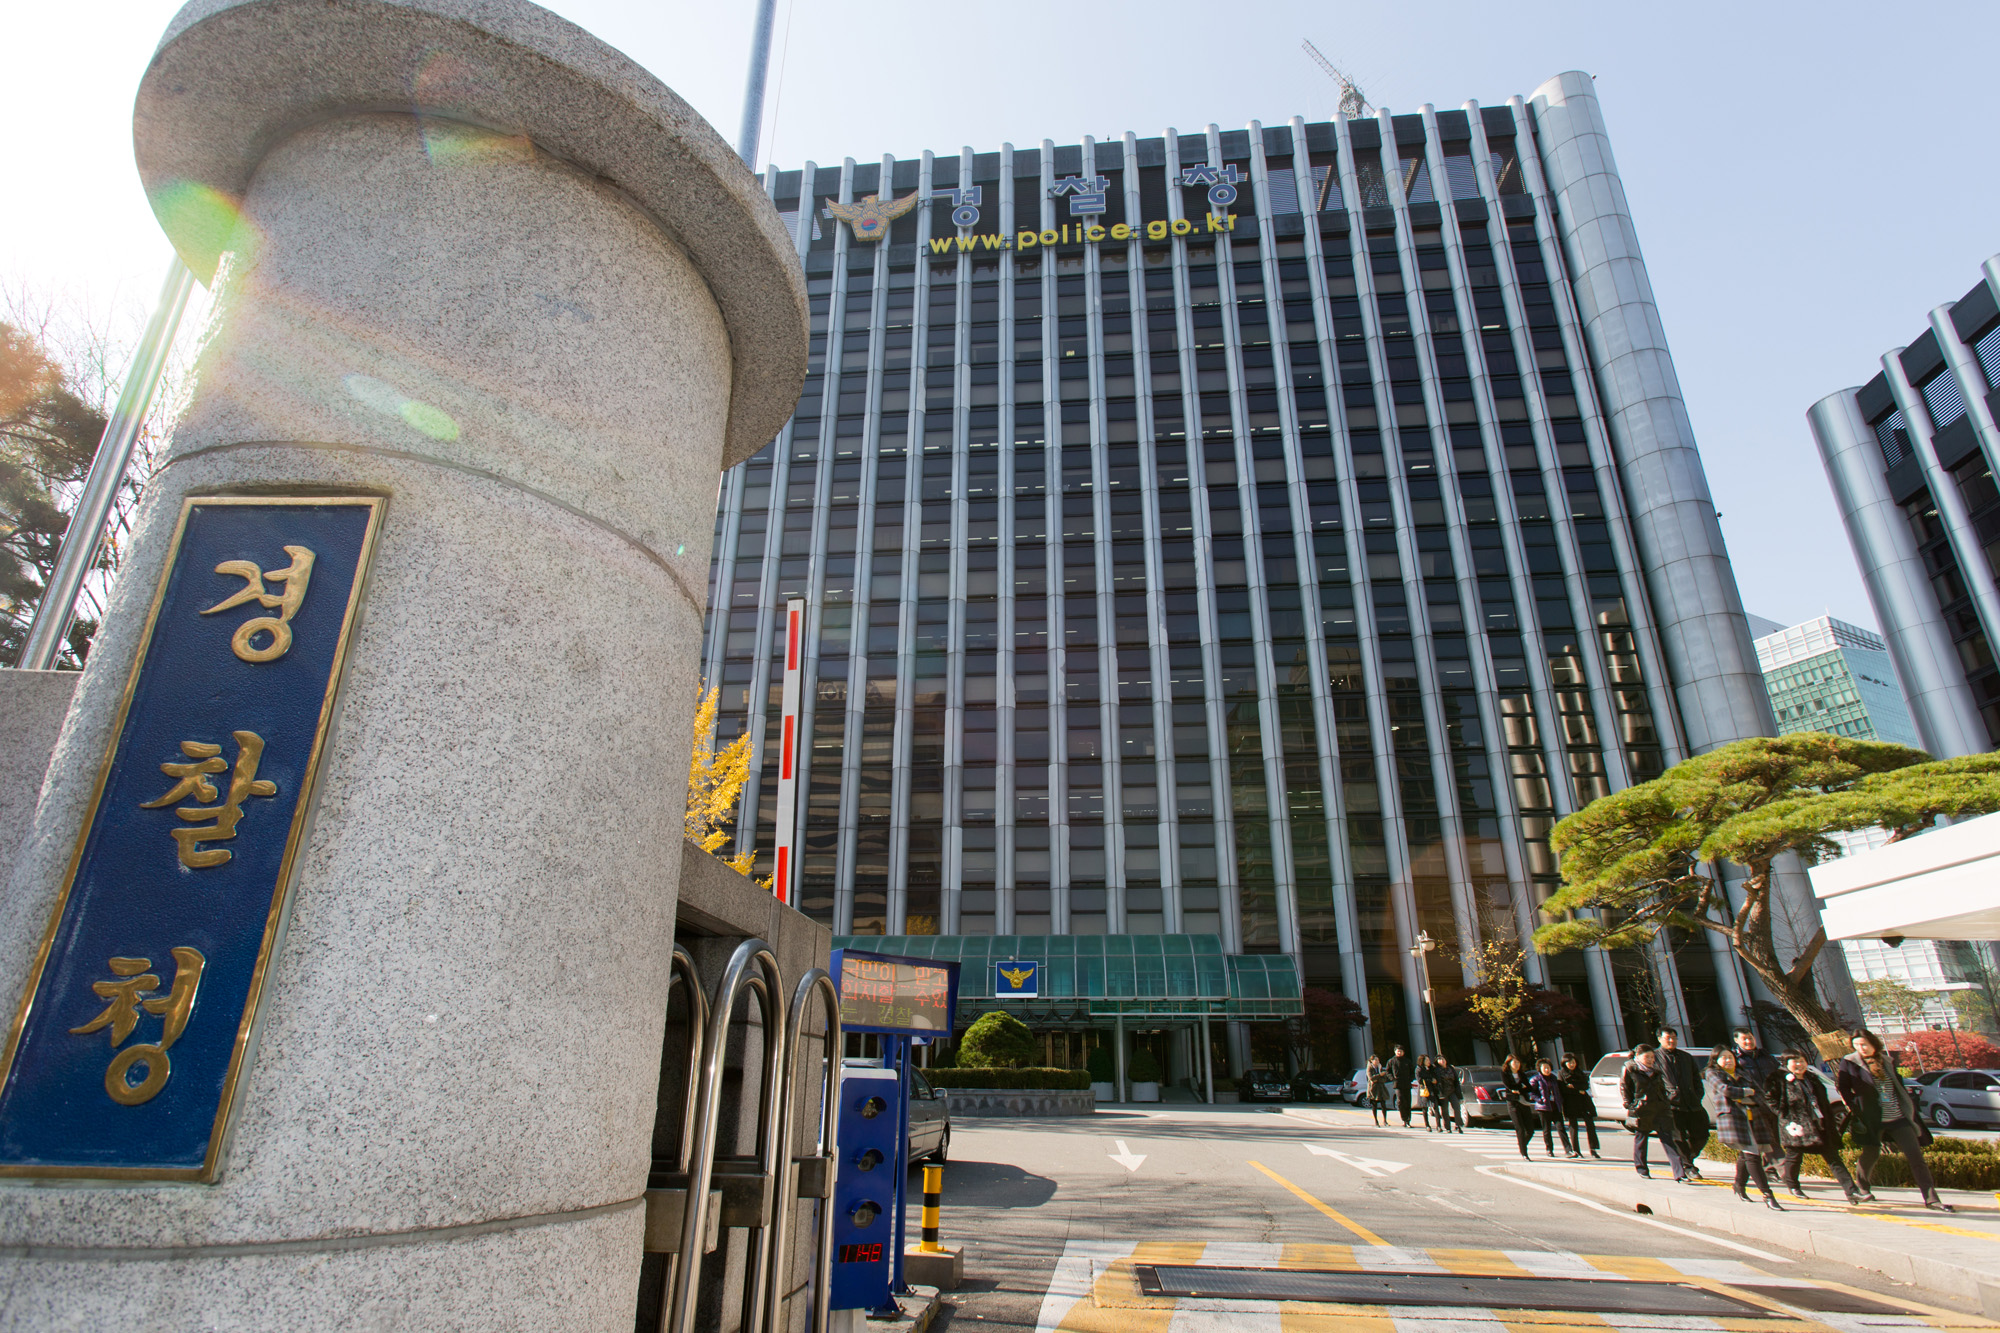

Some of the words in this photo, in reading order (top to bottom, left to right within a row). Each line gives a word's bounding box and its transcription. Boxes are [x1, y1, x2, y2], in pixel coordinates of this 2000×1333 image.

[929, 212, 1238, 255] www.police.go.kr
[71, 545, 316, 1106] 경찰청
[842, 959, 896, 982] 국민이
[841, 979, 896, 1004] 의지할
[878, 1005, 913, 1026] 경찰
